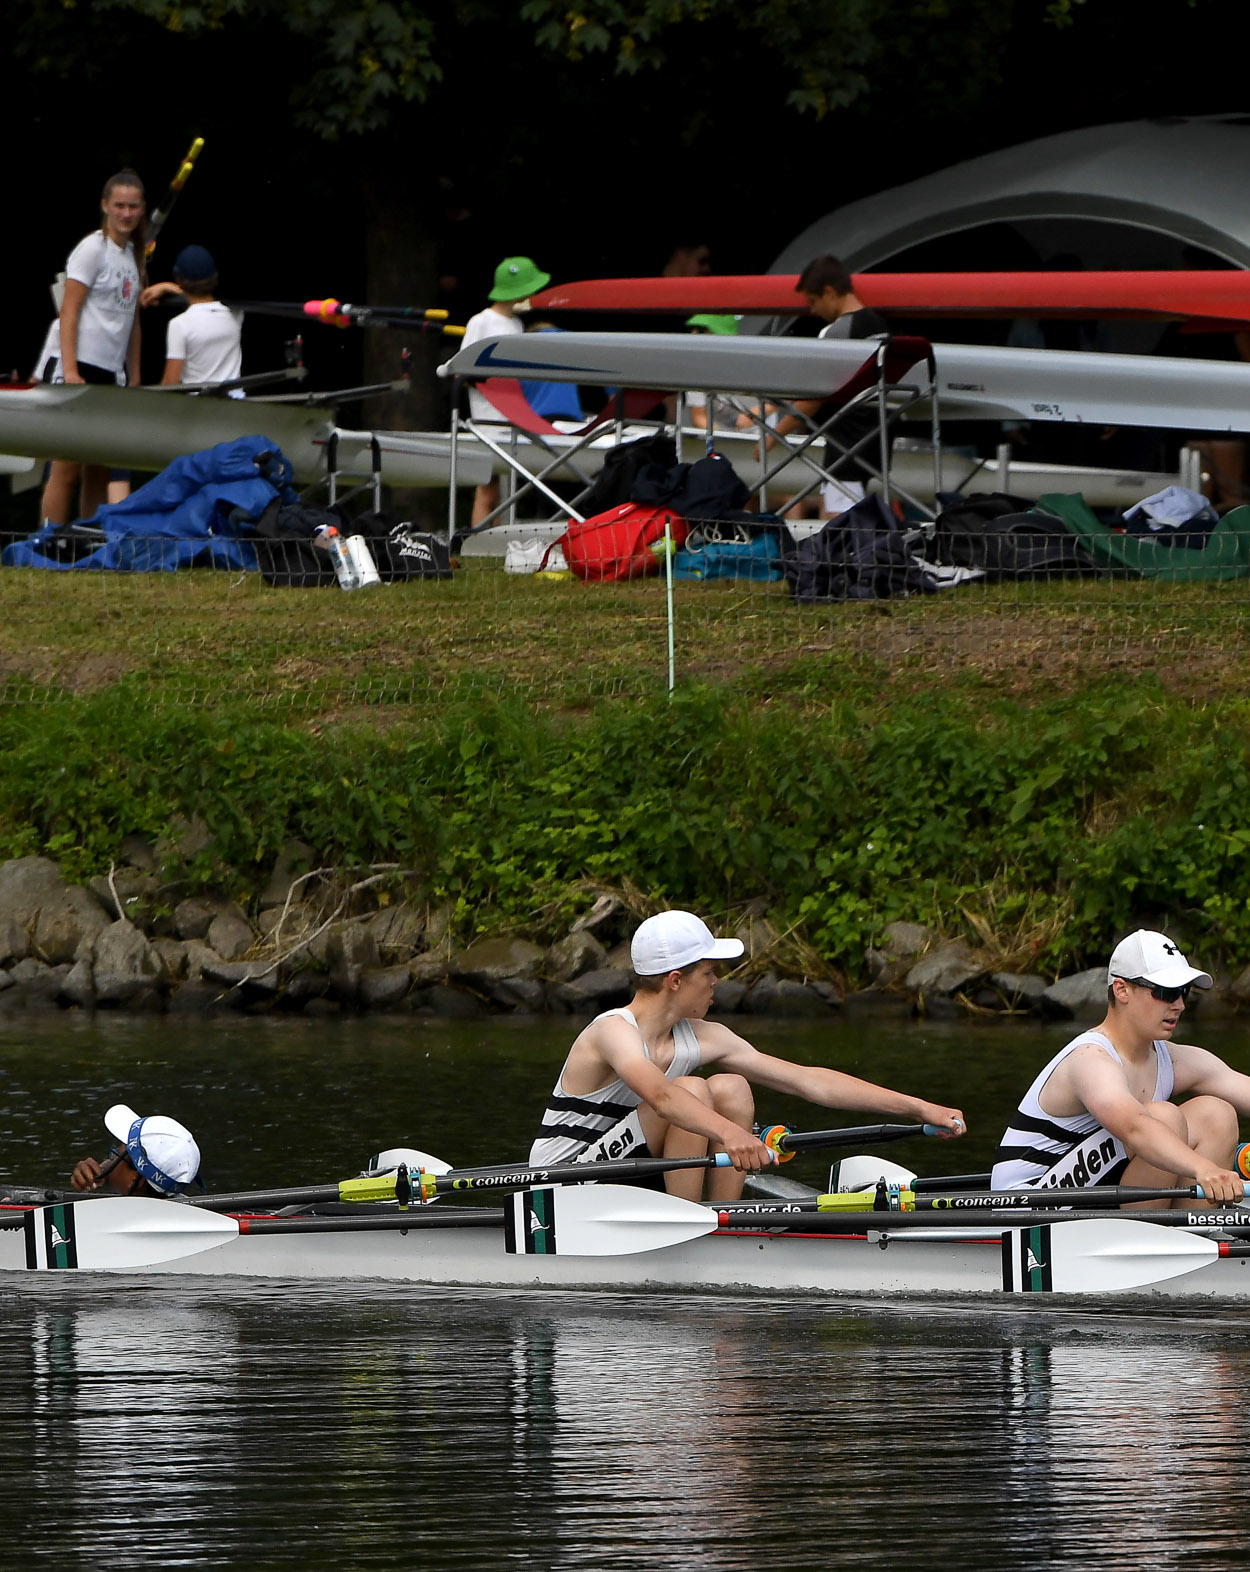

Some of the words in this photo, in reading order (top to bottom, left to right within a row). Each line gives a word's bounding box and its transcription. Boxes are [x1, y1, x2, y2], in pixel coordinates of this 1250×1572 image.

[152, 1171, 167, 1185] NK
[476, 1174, 536, 1186] concept
[540, 1171, 549, 1181] 2
[955, 1197, 1016, 1207] concept
[1020, 1195, 1029, 1205] 2
